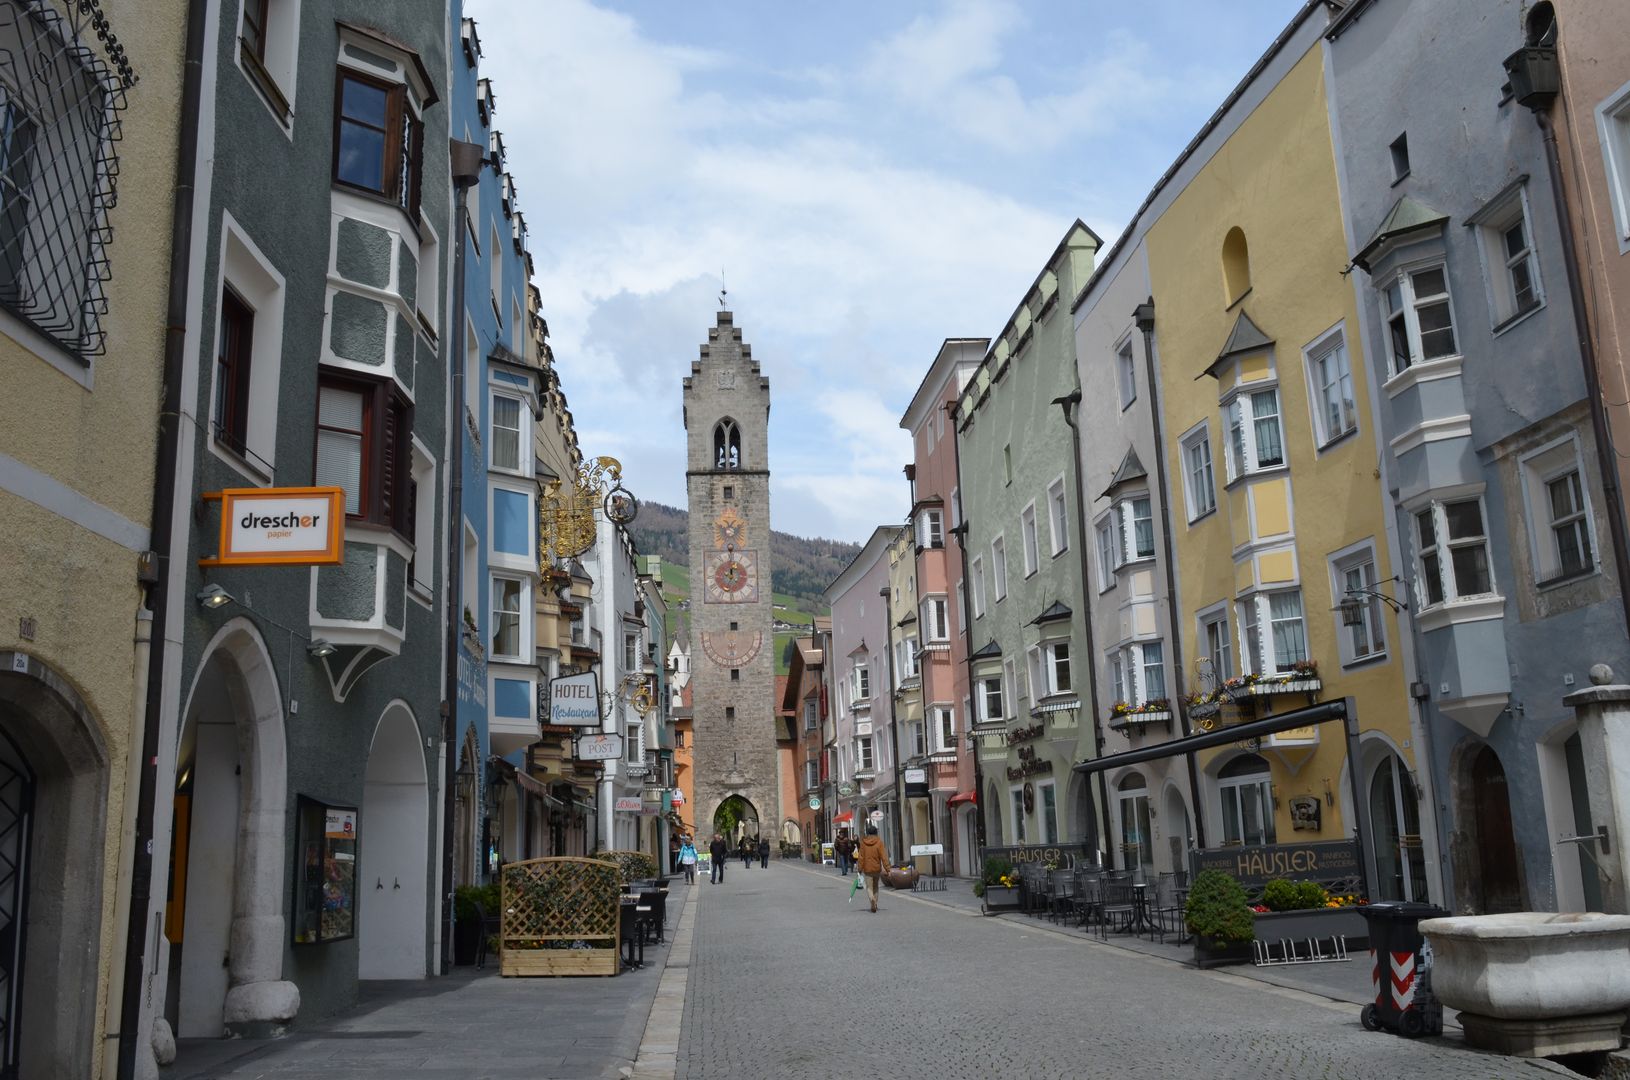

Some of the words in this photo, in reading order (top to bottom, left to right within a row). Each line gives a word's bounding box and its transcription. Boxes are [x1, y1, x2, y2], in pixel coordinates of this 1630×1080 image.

[241, 511, 319, 529] drescher
[267, 530, 292, 539] papier
[555, 684, 594, 699] HOTEL
[552, 704, 598, 720] Restaurant
[588, 743, 615, 754] POST
[1010, 848, 1060, 864] HÄUSLER
[1237, 850, 1318, 876] HÄUSLER
